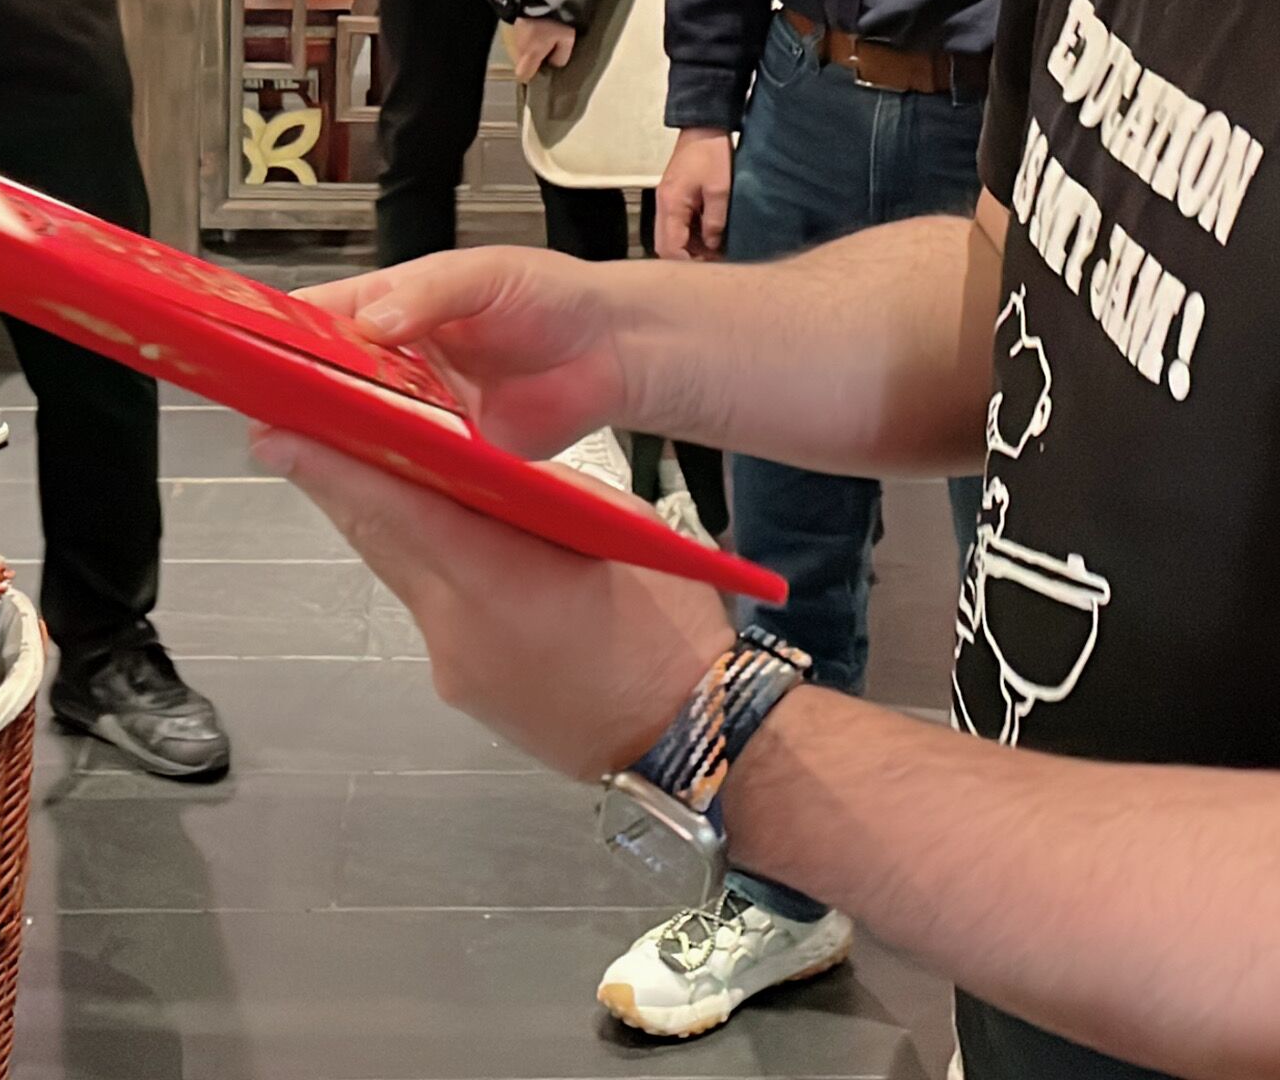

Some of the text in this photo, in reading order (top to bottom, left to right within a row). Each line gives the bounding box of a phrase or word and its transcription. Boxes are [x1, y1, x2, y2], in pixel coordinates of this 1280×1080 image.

[1012, 117, 1206, 401] IS MY JAM!
